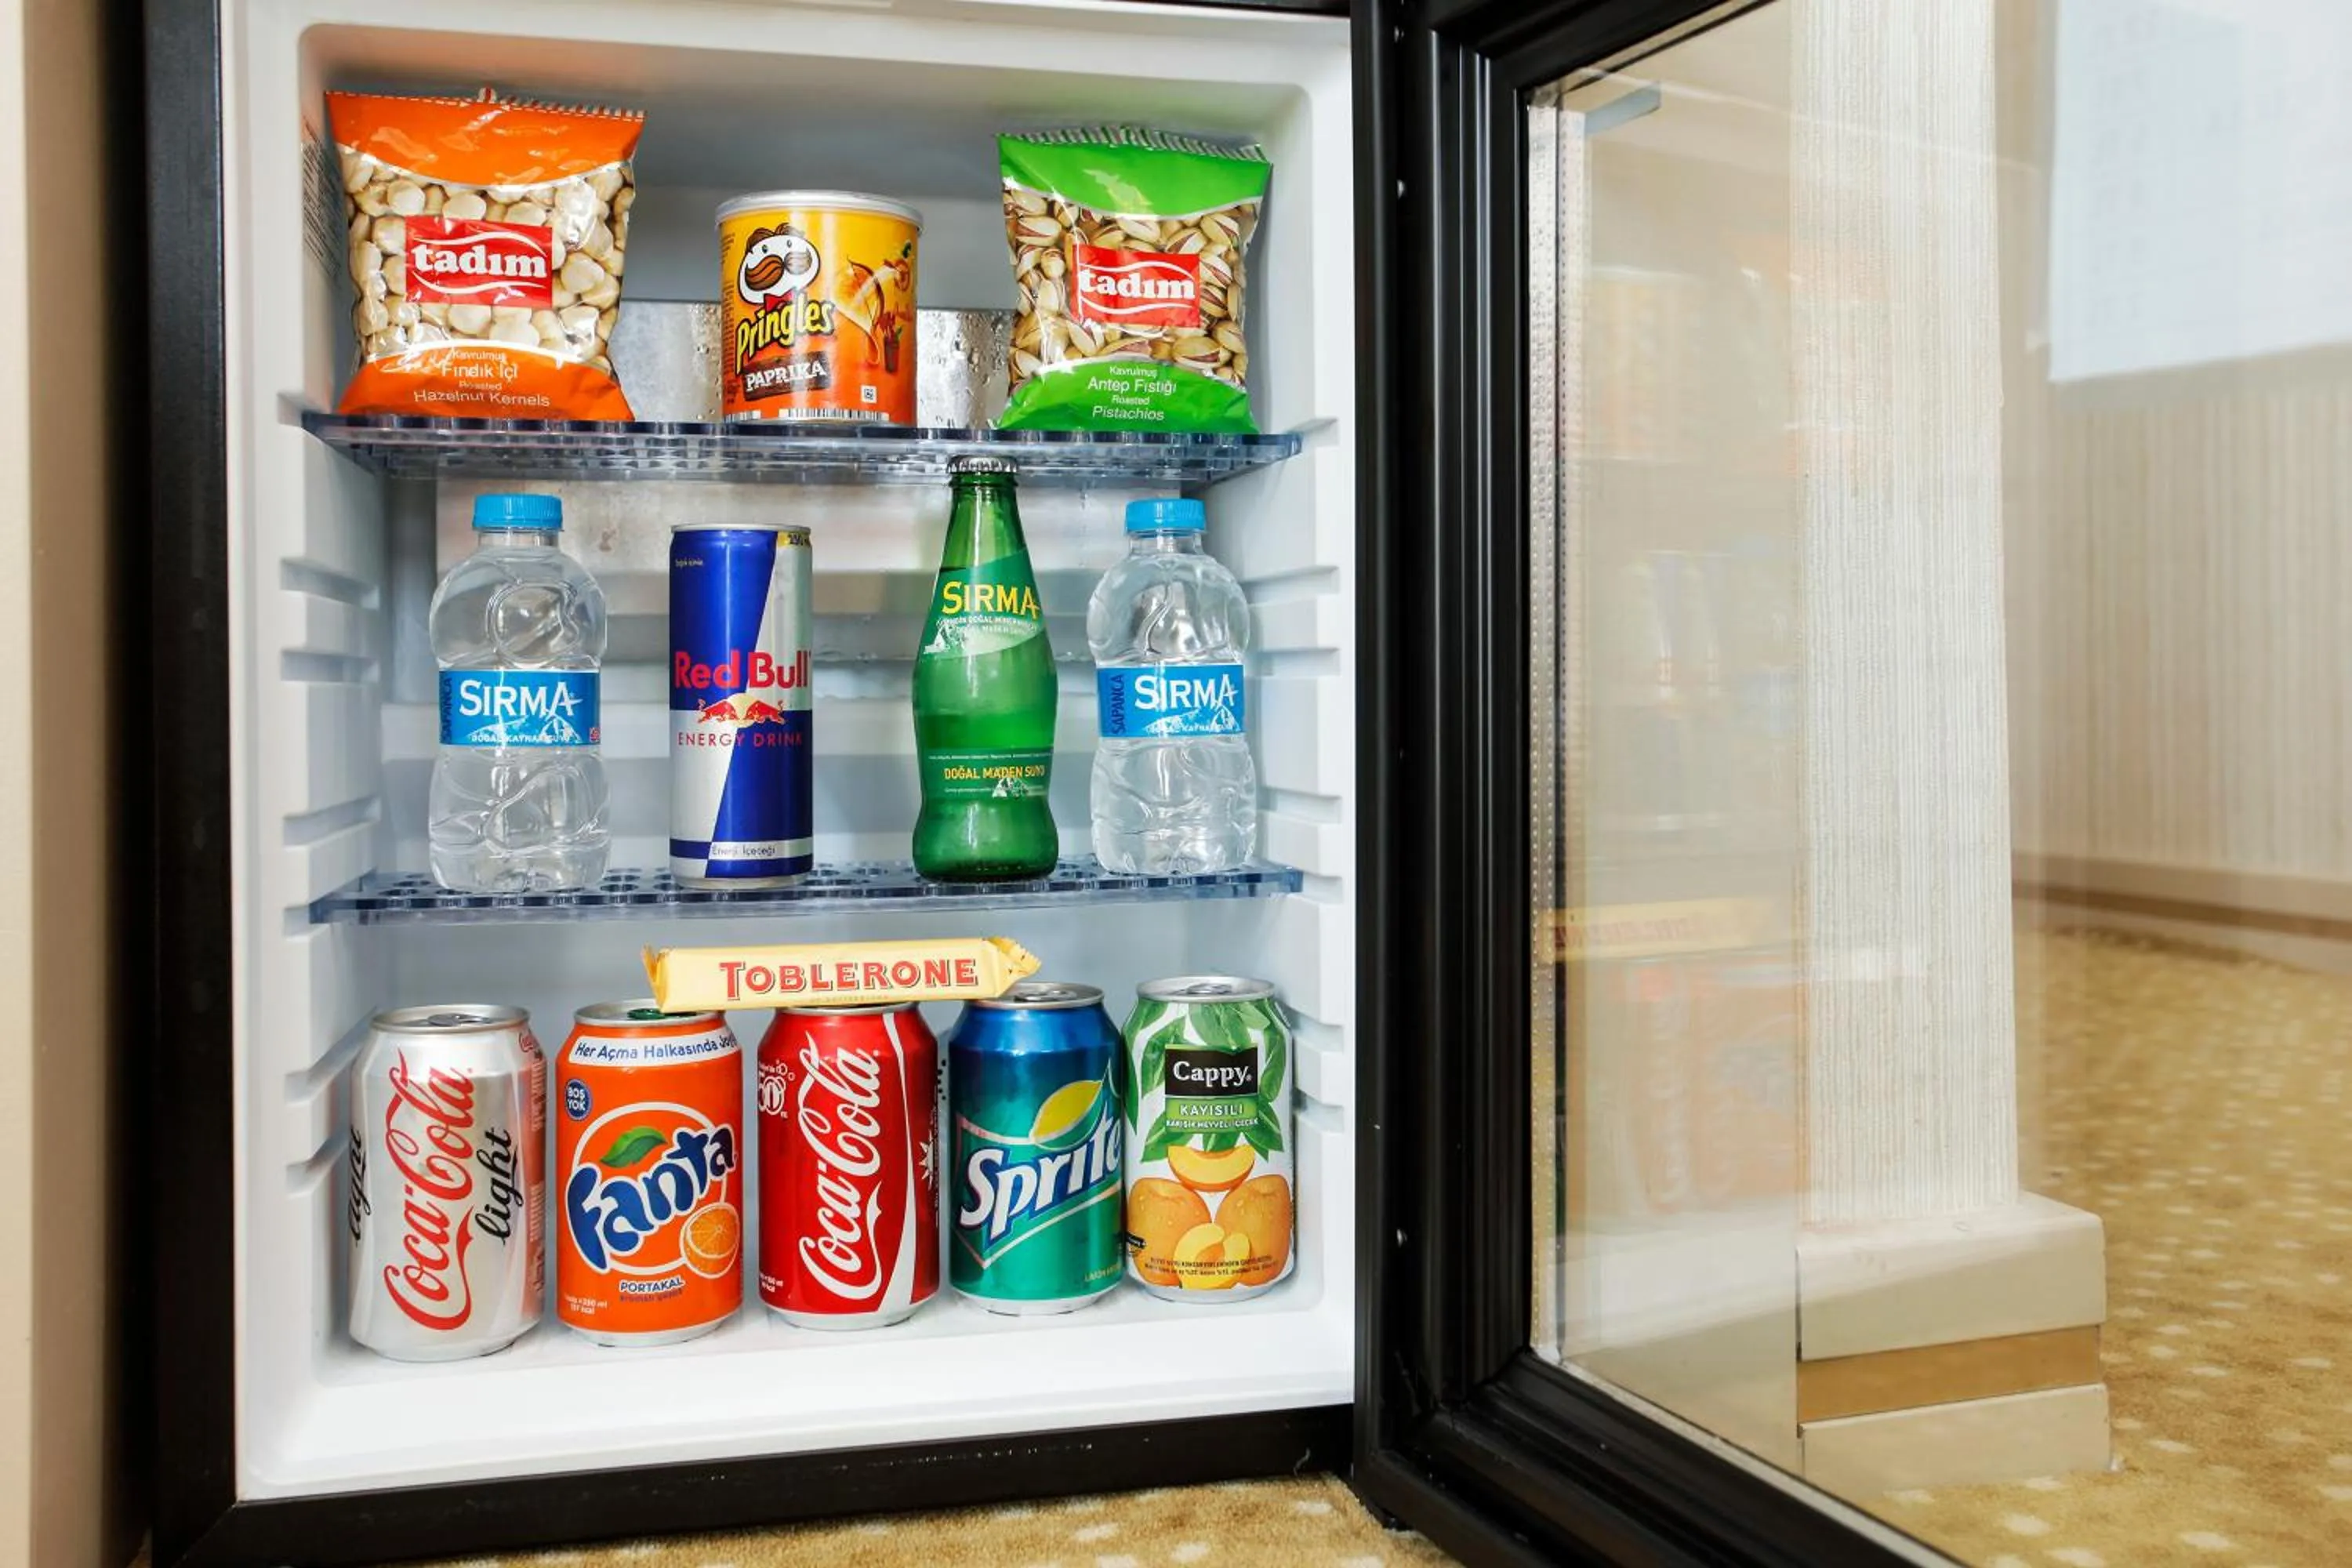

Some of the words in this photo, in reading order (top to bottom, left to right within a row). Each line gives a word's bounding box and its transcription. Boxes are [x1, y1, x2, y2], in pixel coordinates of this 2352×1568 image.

[412, 243, 547, 278] tadım
[1080, 268, 1196, 300] tadım
[735, 291, 834, 374] Pringles
[441, 364, 494, 377] Fındık
[746, 361, 827, 392] PAPRIKA
[1087, 376, 1130, 394] Antep
[413, 389, 485, 402] Hazelnut
[489, 393, 550, 407] Kernels
[1092, 405, 1165, 421] Pistachios
[1112, 394, 1150, 405] Roasted
[942, 581, 1040, 619] SIRMA
[675, 650, 741, 689] Red
[748, 650, 808, 689] Bull
[459, 680, 581, 717] SIRMA
[1109, 674, 1125, 735] SAPANCA
[1134, 673, 1239, 710] SIRMA
[677, 731, 744, 746] ENERGY
[753, 732, 803, 747] DRINK
[944, 765, 980, 779] DOĞAL
[982, 766, 1022, 779] MADEN
[719, 958, 978, 1000] TOBLERONE
[575, 1041, 597, 1057] Her
[597, 1045, 637, 1061] Açma
[644, 1038, 719, 1058] Halkasında
[1173, 1060, 1250, 1088] Cappy
[567, 1100, 586, 1111] YOK
[1179, 1103, 1245, 1116] KAYISILI
[798, 1030, 882, 1300] Coca-Cola
[960, 1100, 1122, 1240] Sprite
[384, 1047, 474, 1330] Coca-Cola
[475, 1127, 524, 1246] light
[567, 1124, 738, 1273] Fanta
[619, 1276, 685, 1293] PORTAKAL
